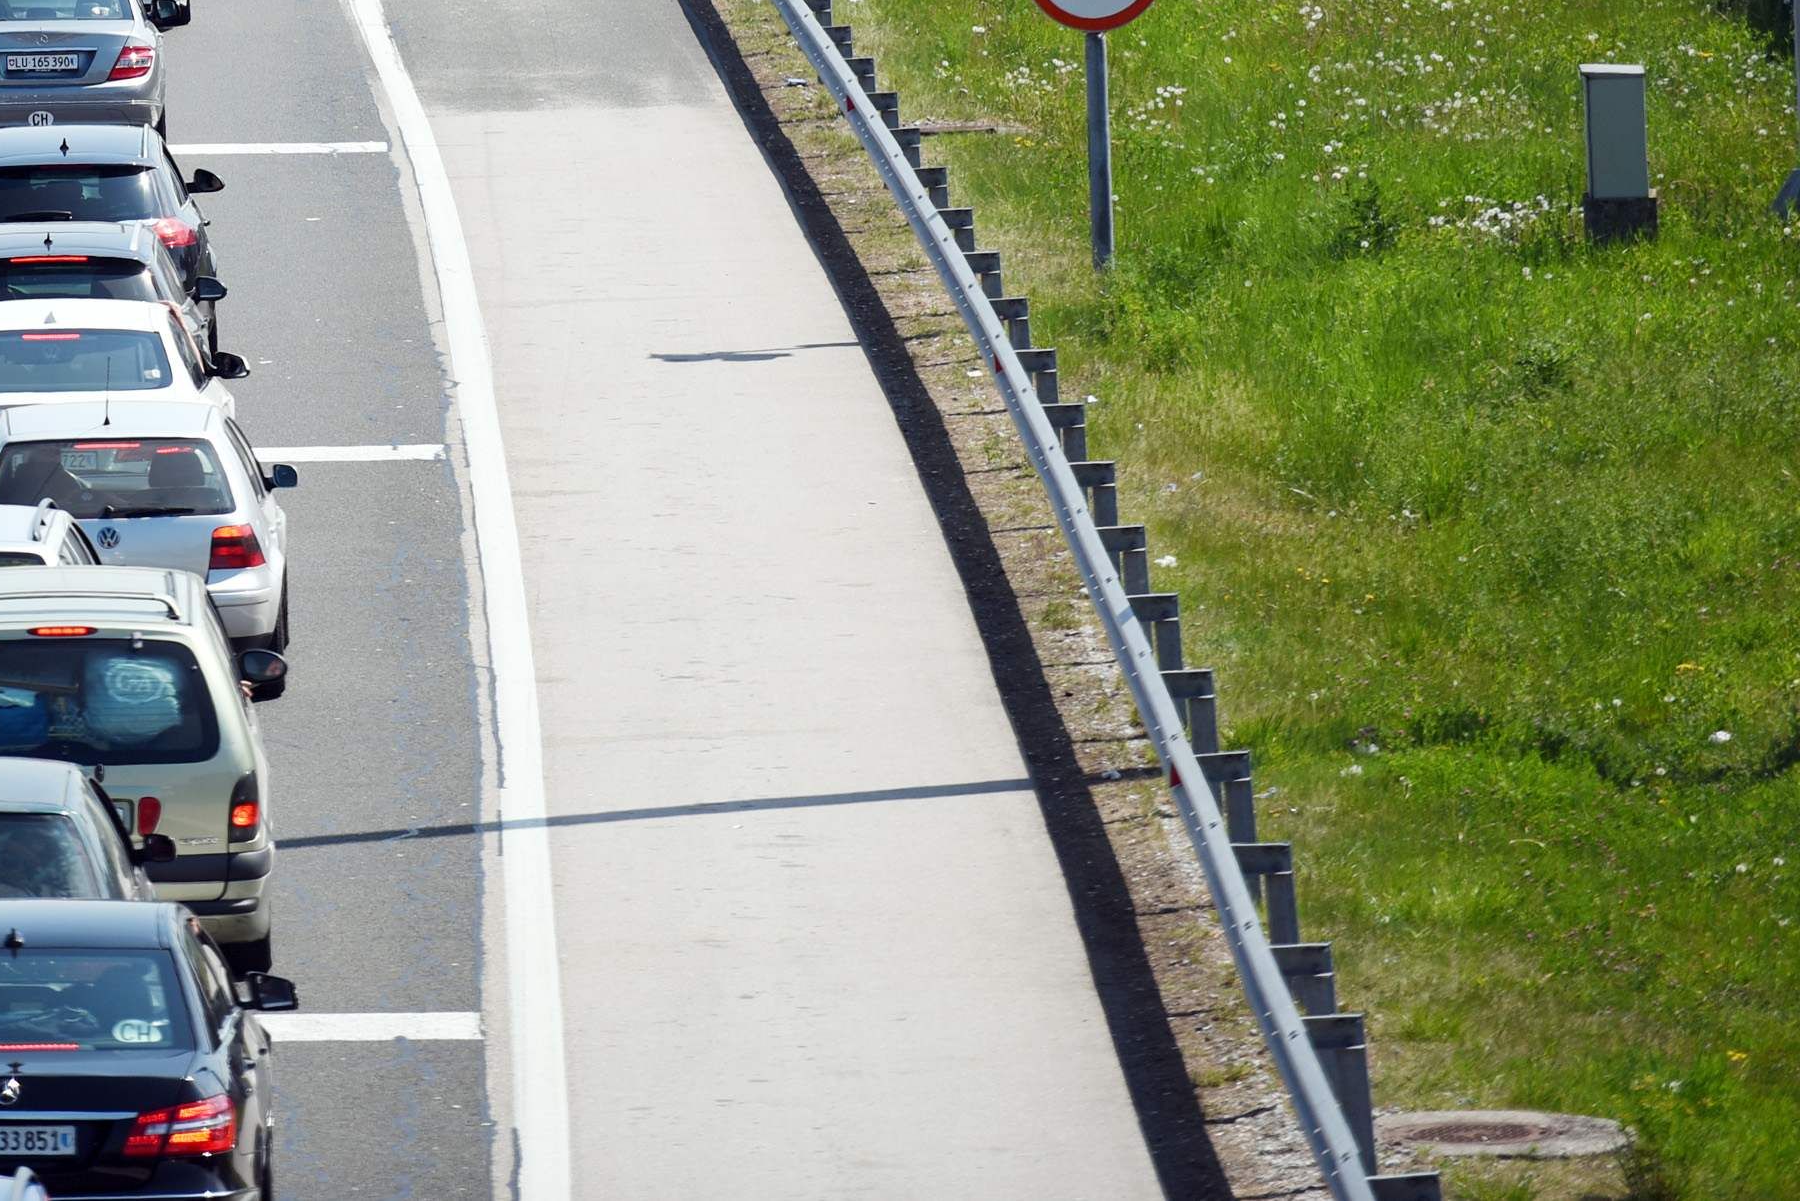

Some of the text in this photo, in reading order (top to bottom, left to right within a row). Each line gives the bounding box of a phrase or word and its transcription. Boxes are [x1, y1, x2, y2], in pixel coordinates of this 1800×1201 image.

[15, 58, 28, 68] LU
[32, 114, 48, 126] CH
[120, 1023, 151, 1041] CH
